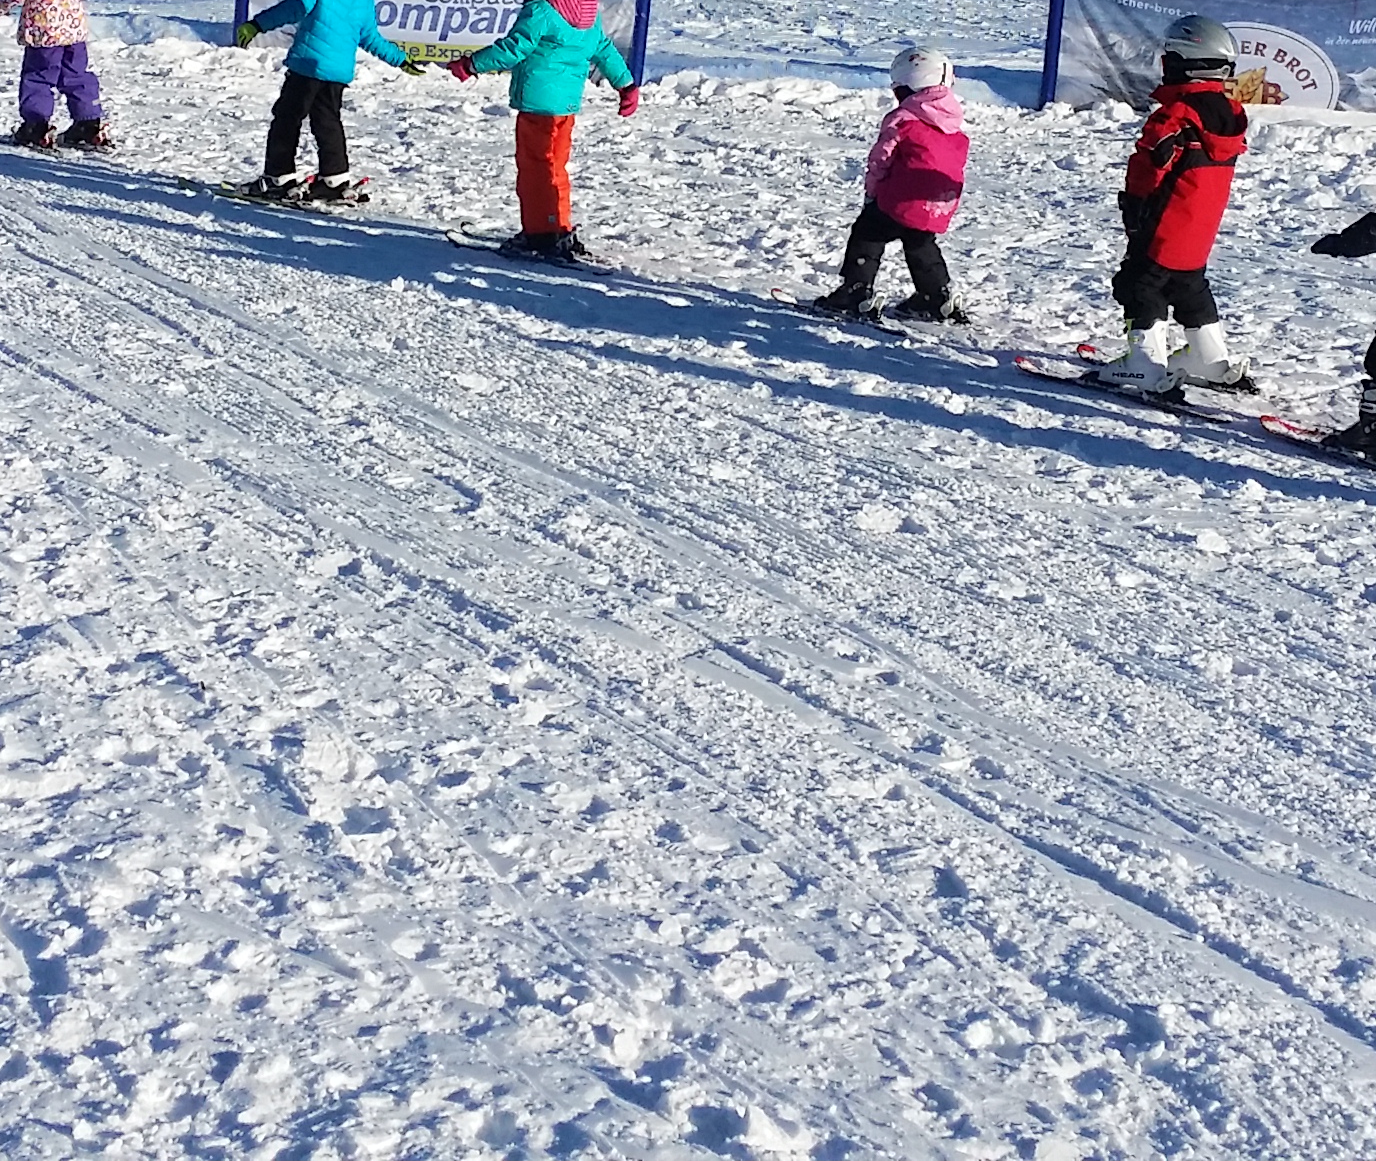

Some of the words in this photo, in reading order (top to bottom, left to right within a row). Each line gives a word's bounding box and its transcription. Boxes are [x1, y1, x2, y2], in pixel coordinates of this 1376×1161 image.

[375, 0, 523, 42] ompan
[424, 44, 474, 60] Expe
[1272, 48, 1318, 90] BROT
